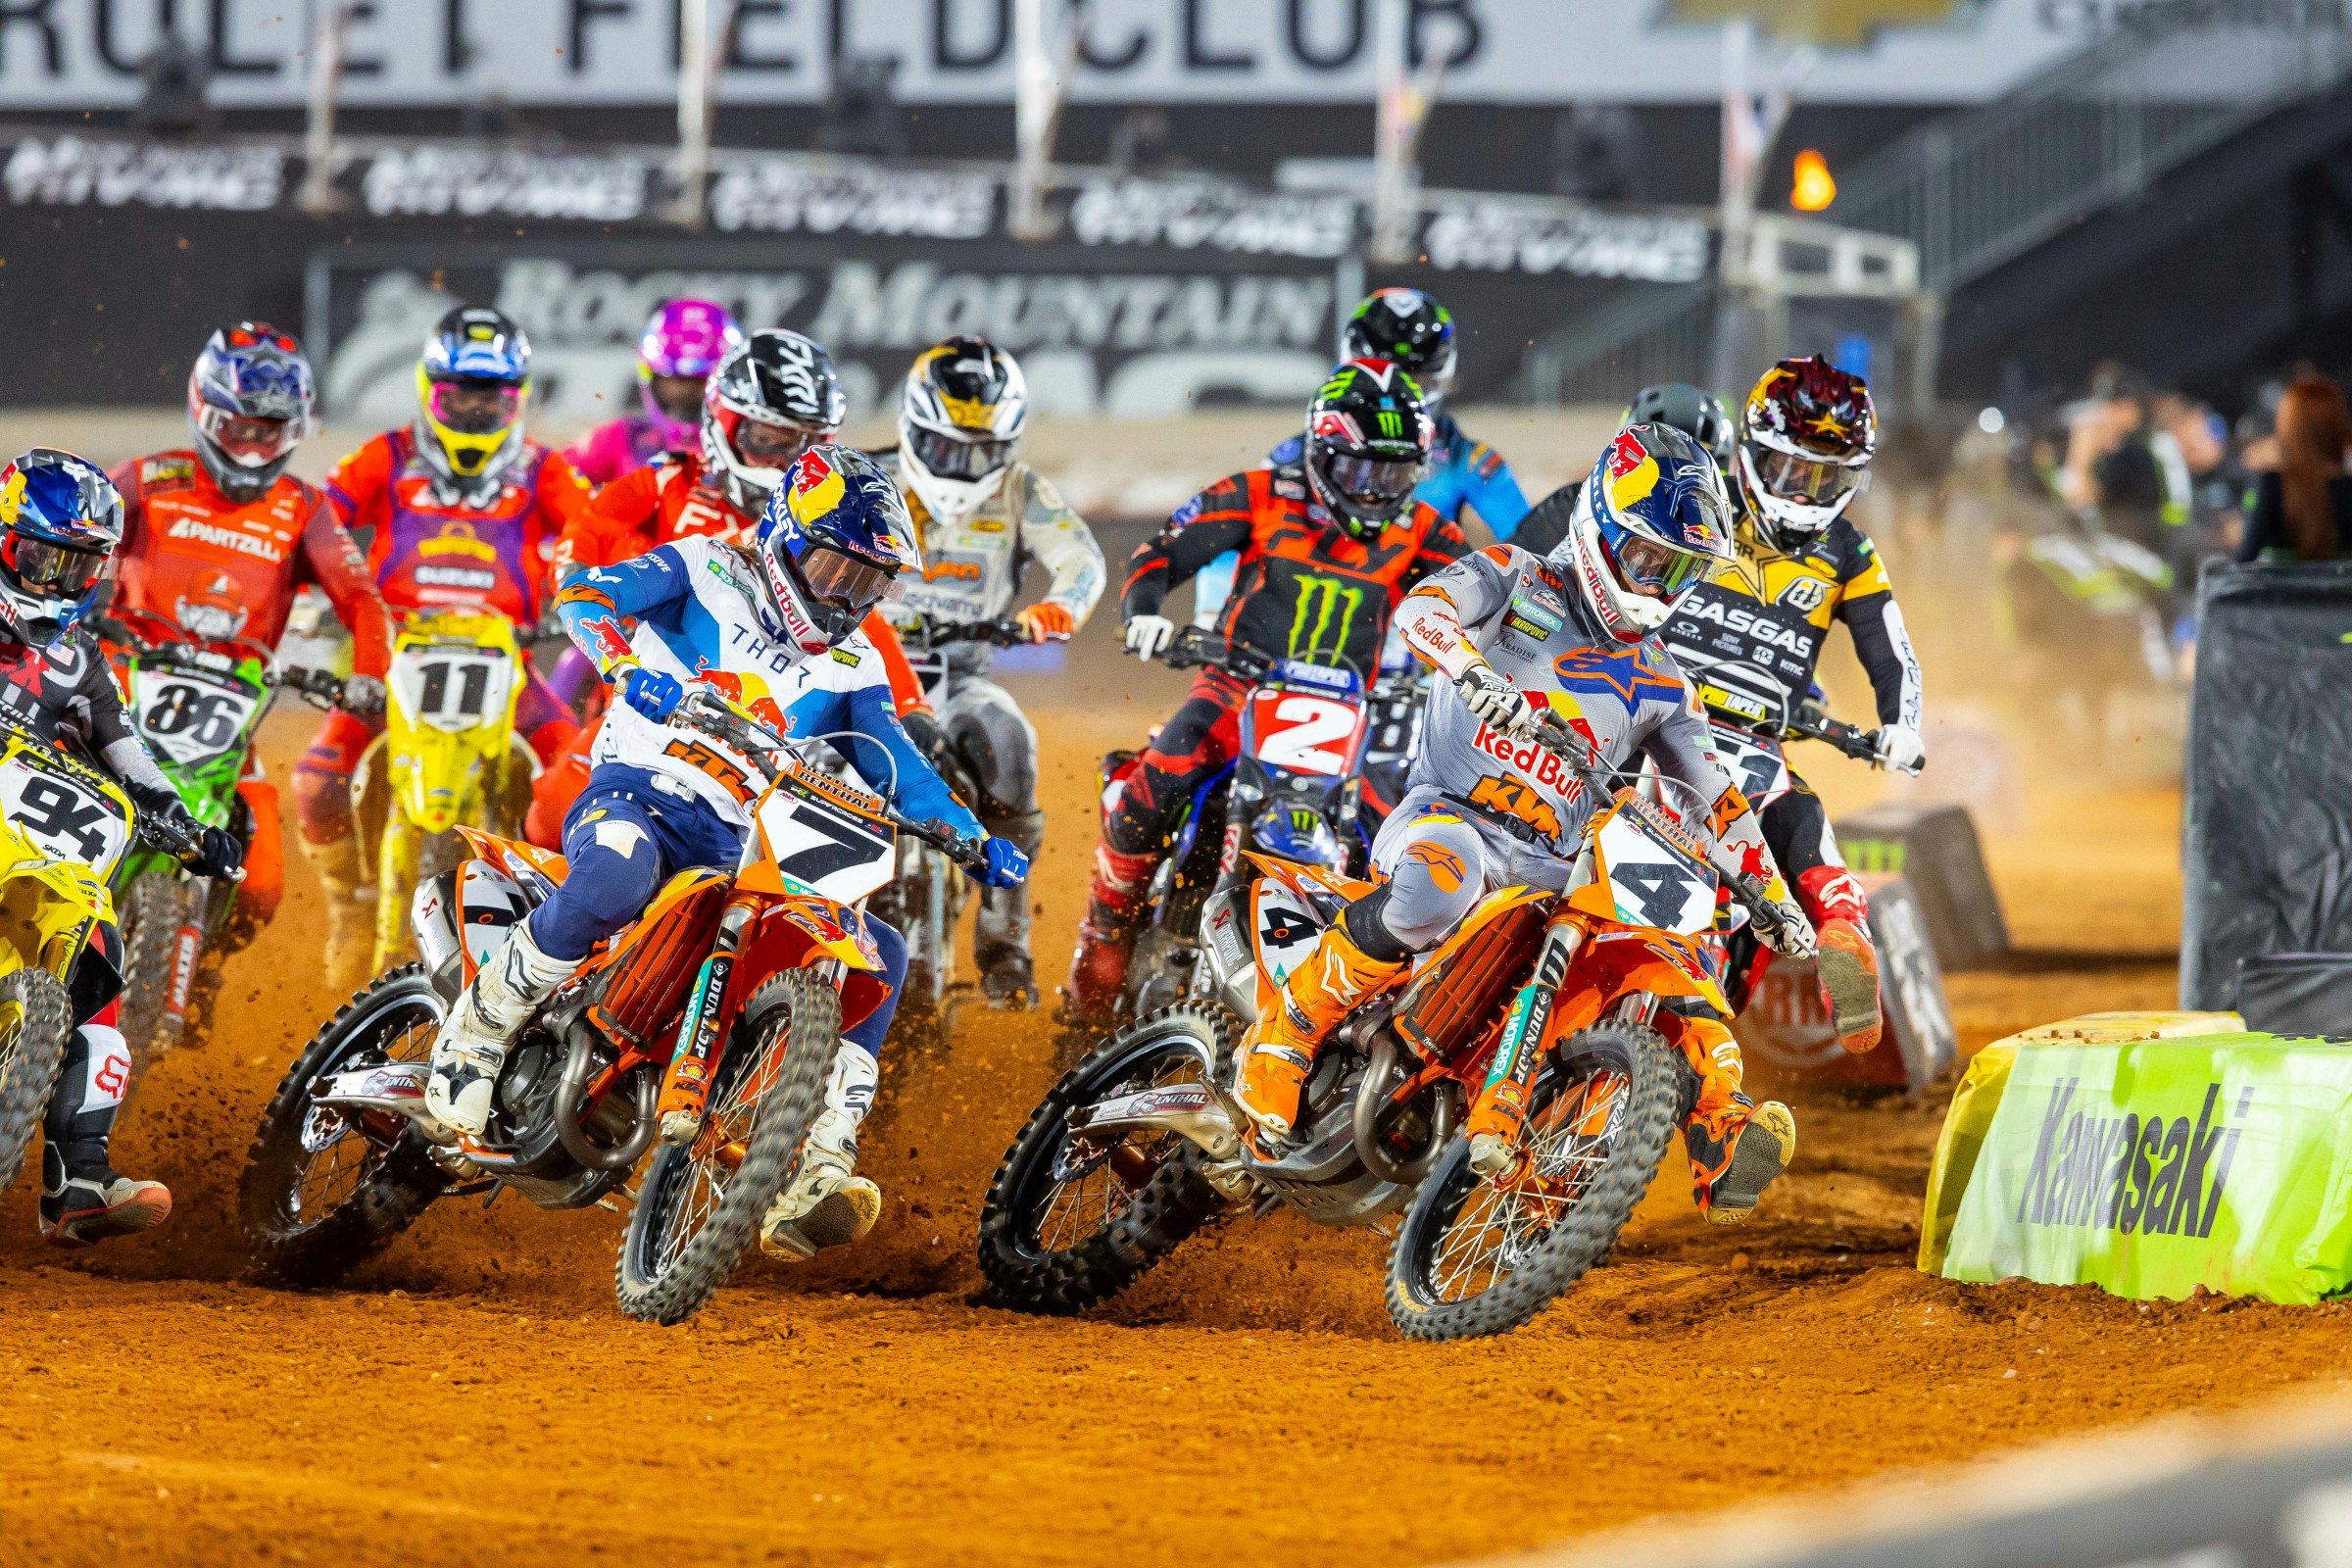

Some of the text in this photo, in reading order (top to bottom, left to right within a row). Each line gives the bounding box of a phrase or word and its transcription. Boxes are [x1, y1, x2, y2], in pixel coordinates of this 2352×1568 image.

[1677, 594, 1813, 660] GASGAS
[144, 683, 244, 748] 86
[417, 662, 489, 714] 11
[1256, 696, 1357, 776] 2
[8, 776, 108, 862] 94
[797, 770, 870, 810] RENTHAL
[809, 795, 863, 824] SUPERCROSS
[777, 805, 888, 885] 7
[1632, 799, 1697, 855] RENTHAL
[1645, 825, 1691, 865] SUPERCROSS
[1259, 906, 1323, 950] 4
[1609, 862, 1700, 930] 4
[673, 992, 700, 1057] MOTOREX
[695, 976, 723, 1059] DUNLOP
[1491, 1016, 1521, 1078] MOTOREX
[2016, 1077, 2255, 1239] Kawasaki
